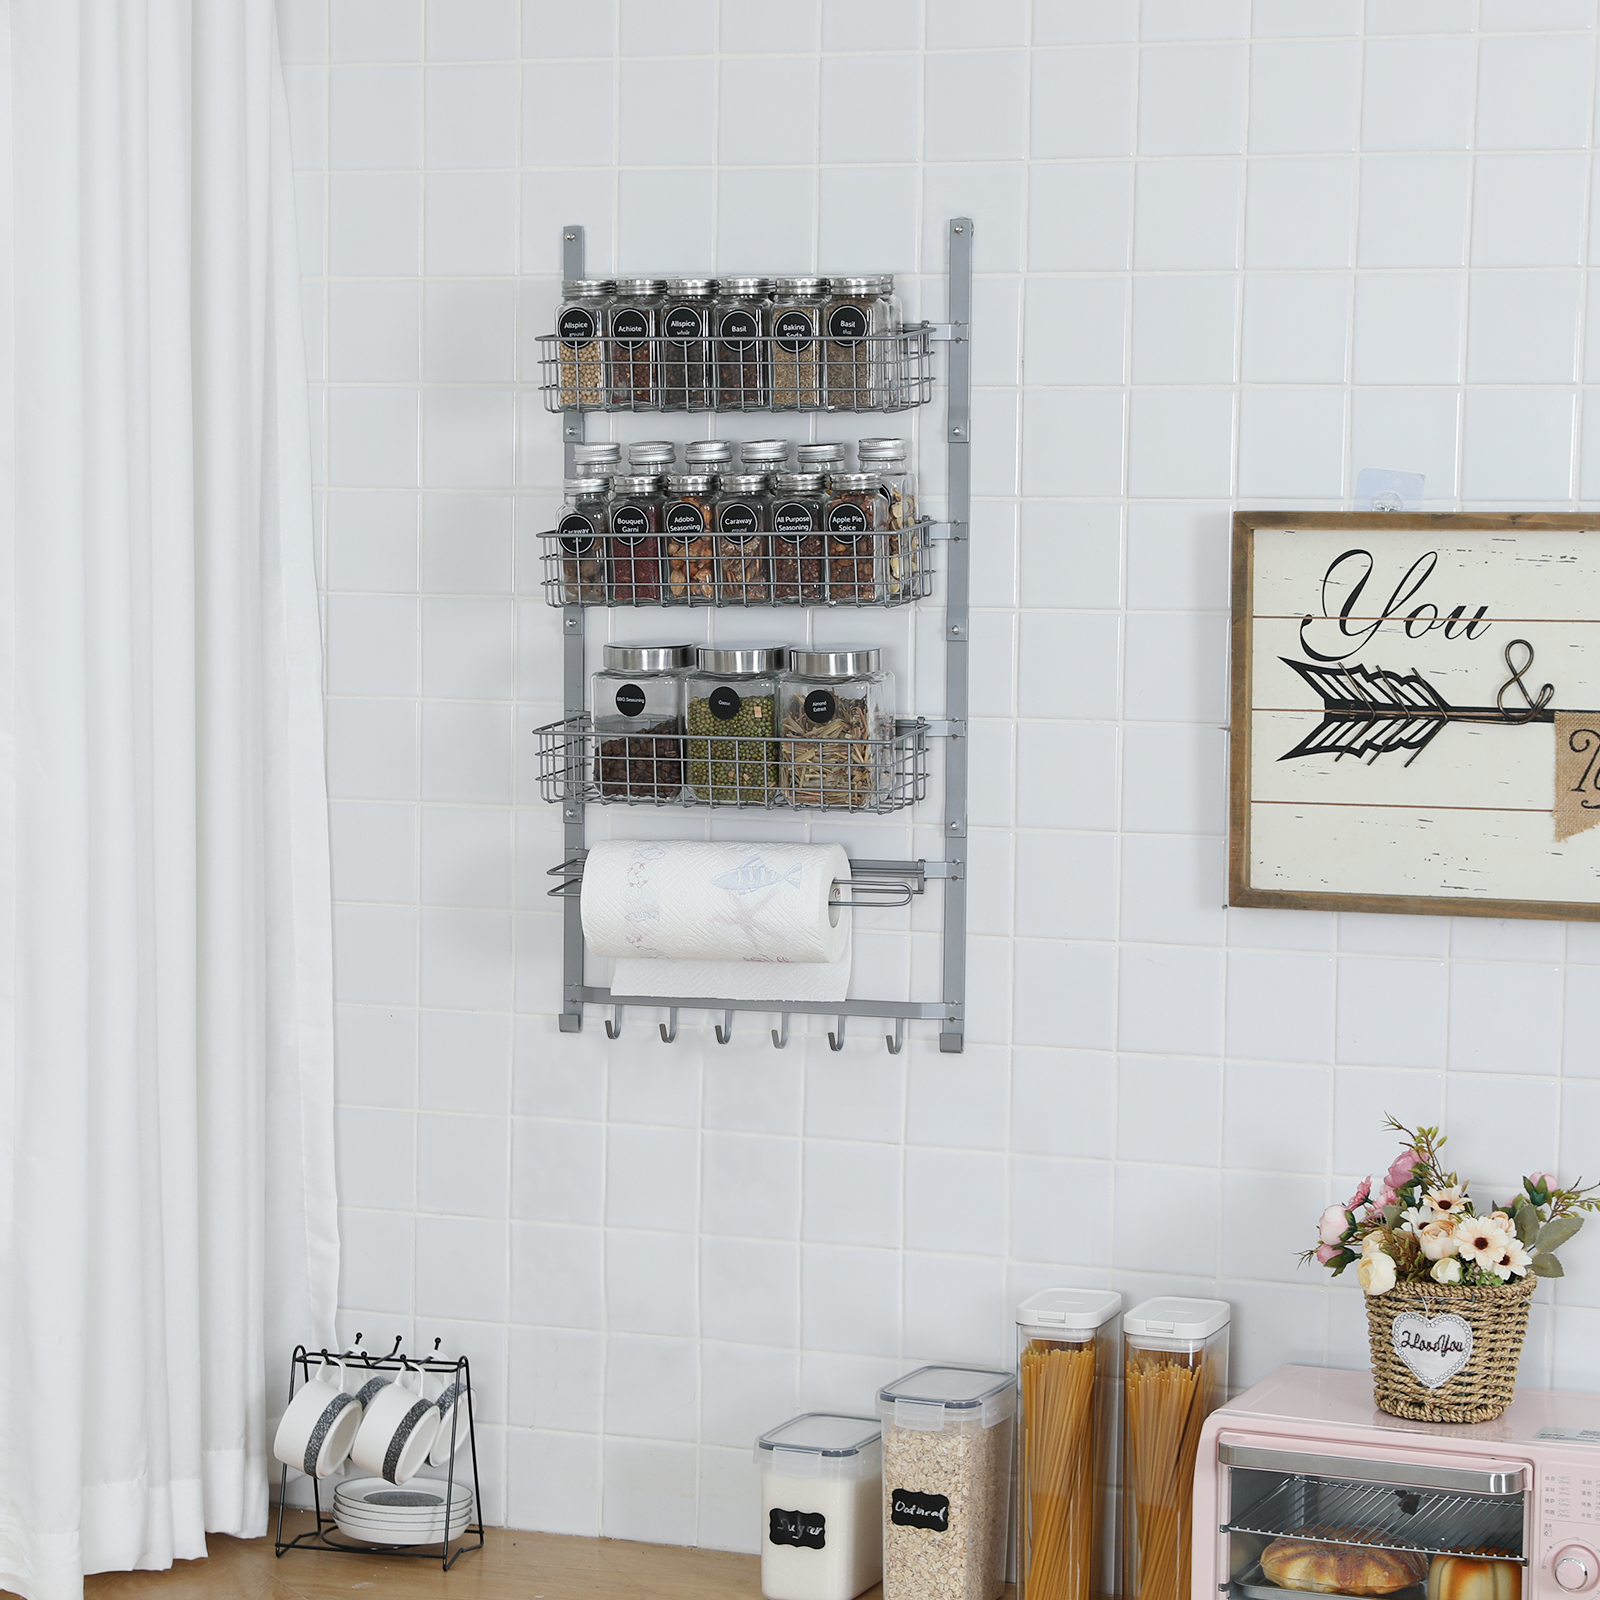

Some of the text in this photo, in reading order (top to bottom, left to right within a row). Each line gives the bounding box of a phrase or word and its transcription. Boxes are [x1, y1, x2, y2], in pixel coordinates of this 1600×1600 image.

[564, 321, 588, 330] Allspice
[670, 320, 696, 328] Allspice
[783, 324, 805, 332] Baking
[840, 320, 856, 328] Basil
[618, 325, 643, 333] Achiote
[731, 325, 747, 333] Basil
[617, 517, 644, 526] Bouquet
[724, 517, 753, 526] Caraway
[785, 516, 810, 524] Purpose
[832, 515, 863, 524] Apple Pie
[669, 523, 701, 532] Seasoning
[778, 524, 809, 532] Seasoning
[838, 524, 857, 532] Spice
[1300, 549, 1492, 662] You
